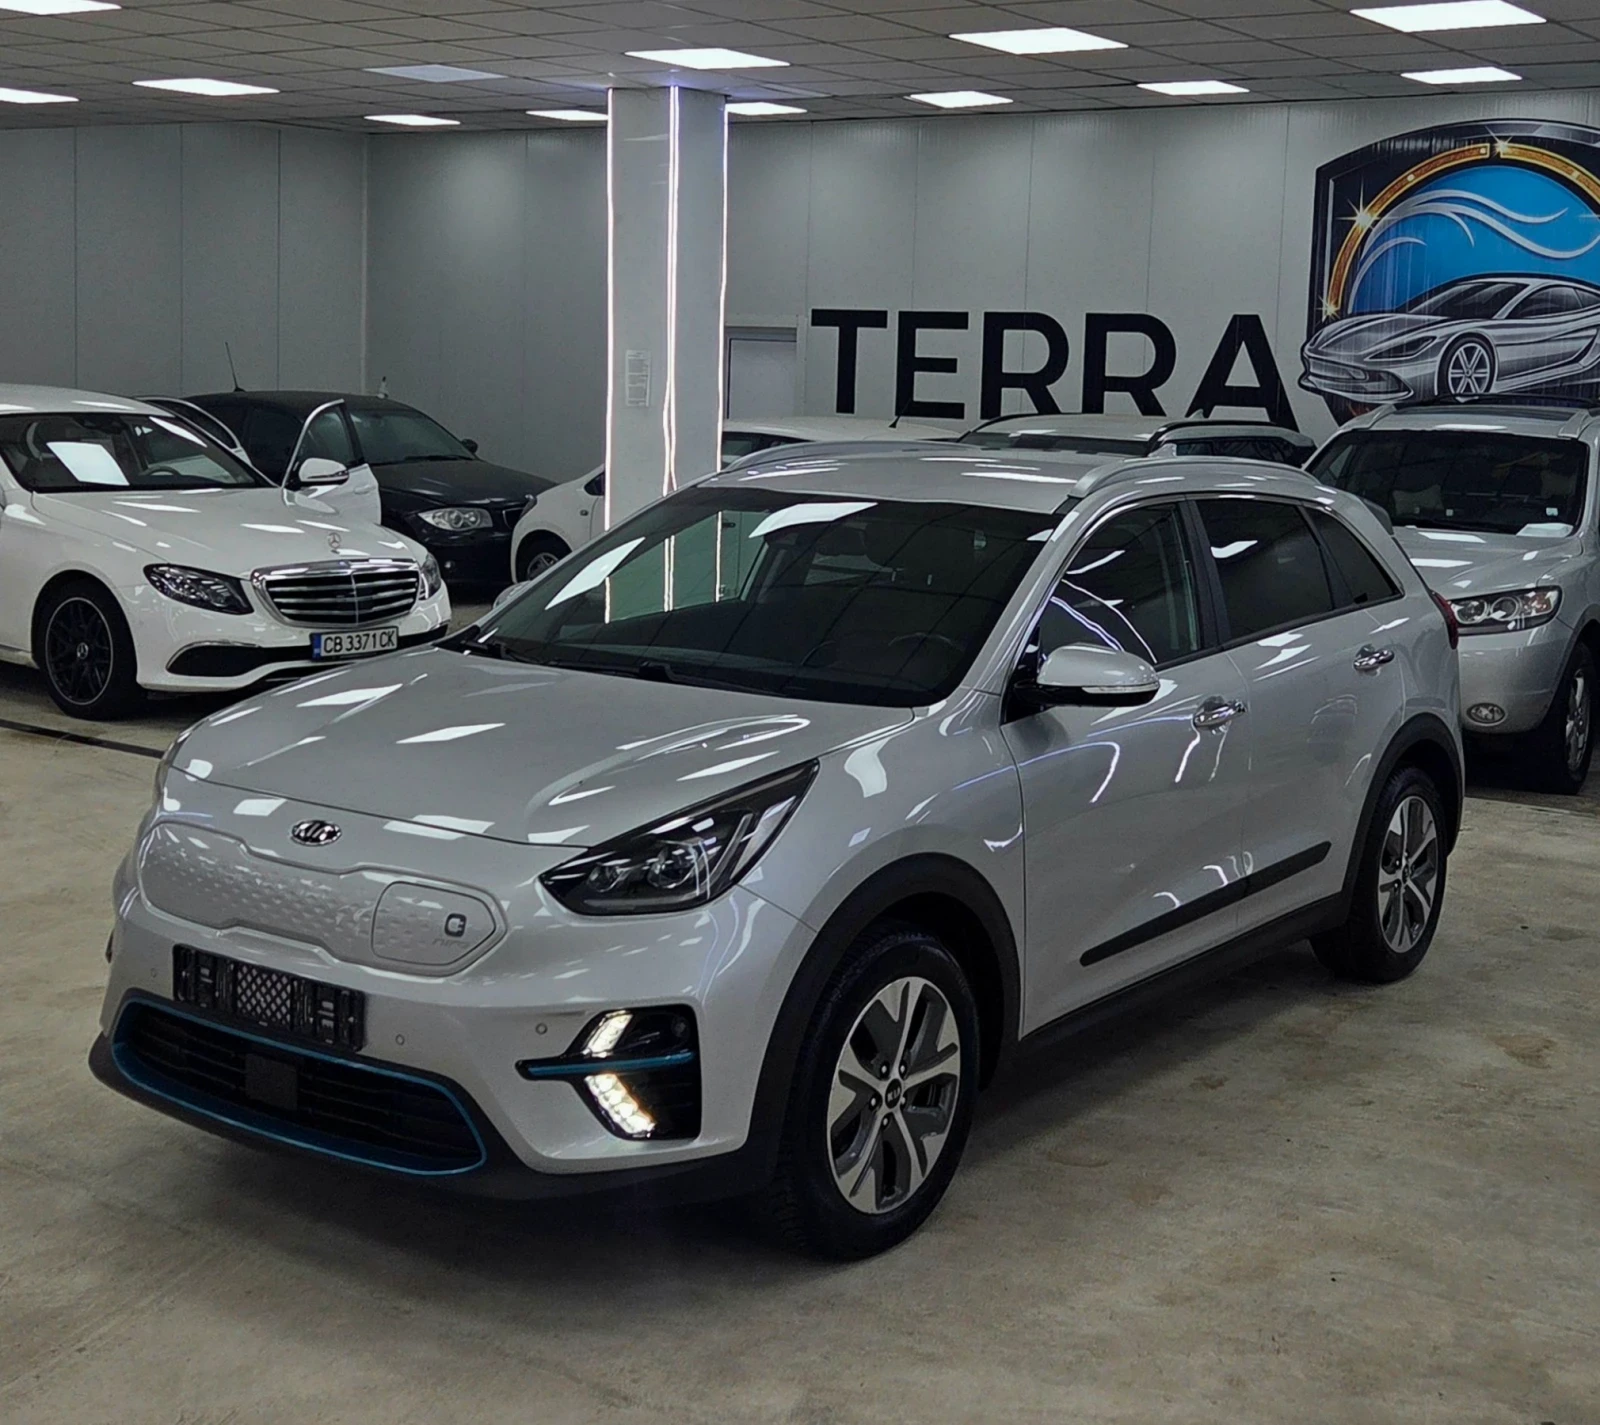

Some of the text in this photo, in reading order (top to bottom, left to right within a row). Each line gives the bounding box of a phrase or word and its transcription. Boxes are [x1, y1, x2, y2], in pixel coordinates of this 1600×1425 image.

[811, 308, 1298, 431] TERRA
[324, 630, 395, 654] CB 3371 CK
